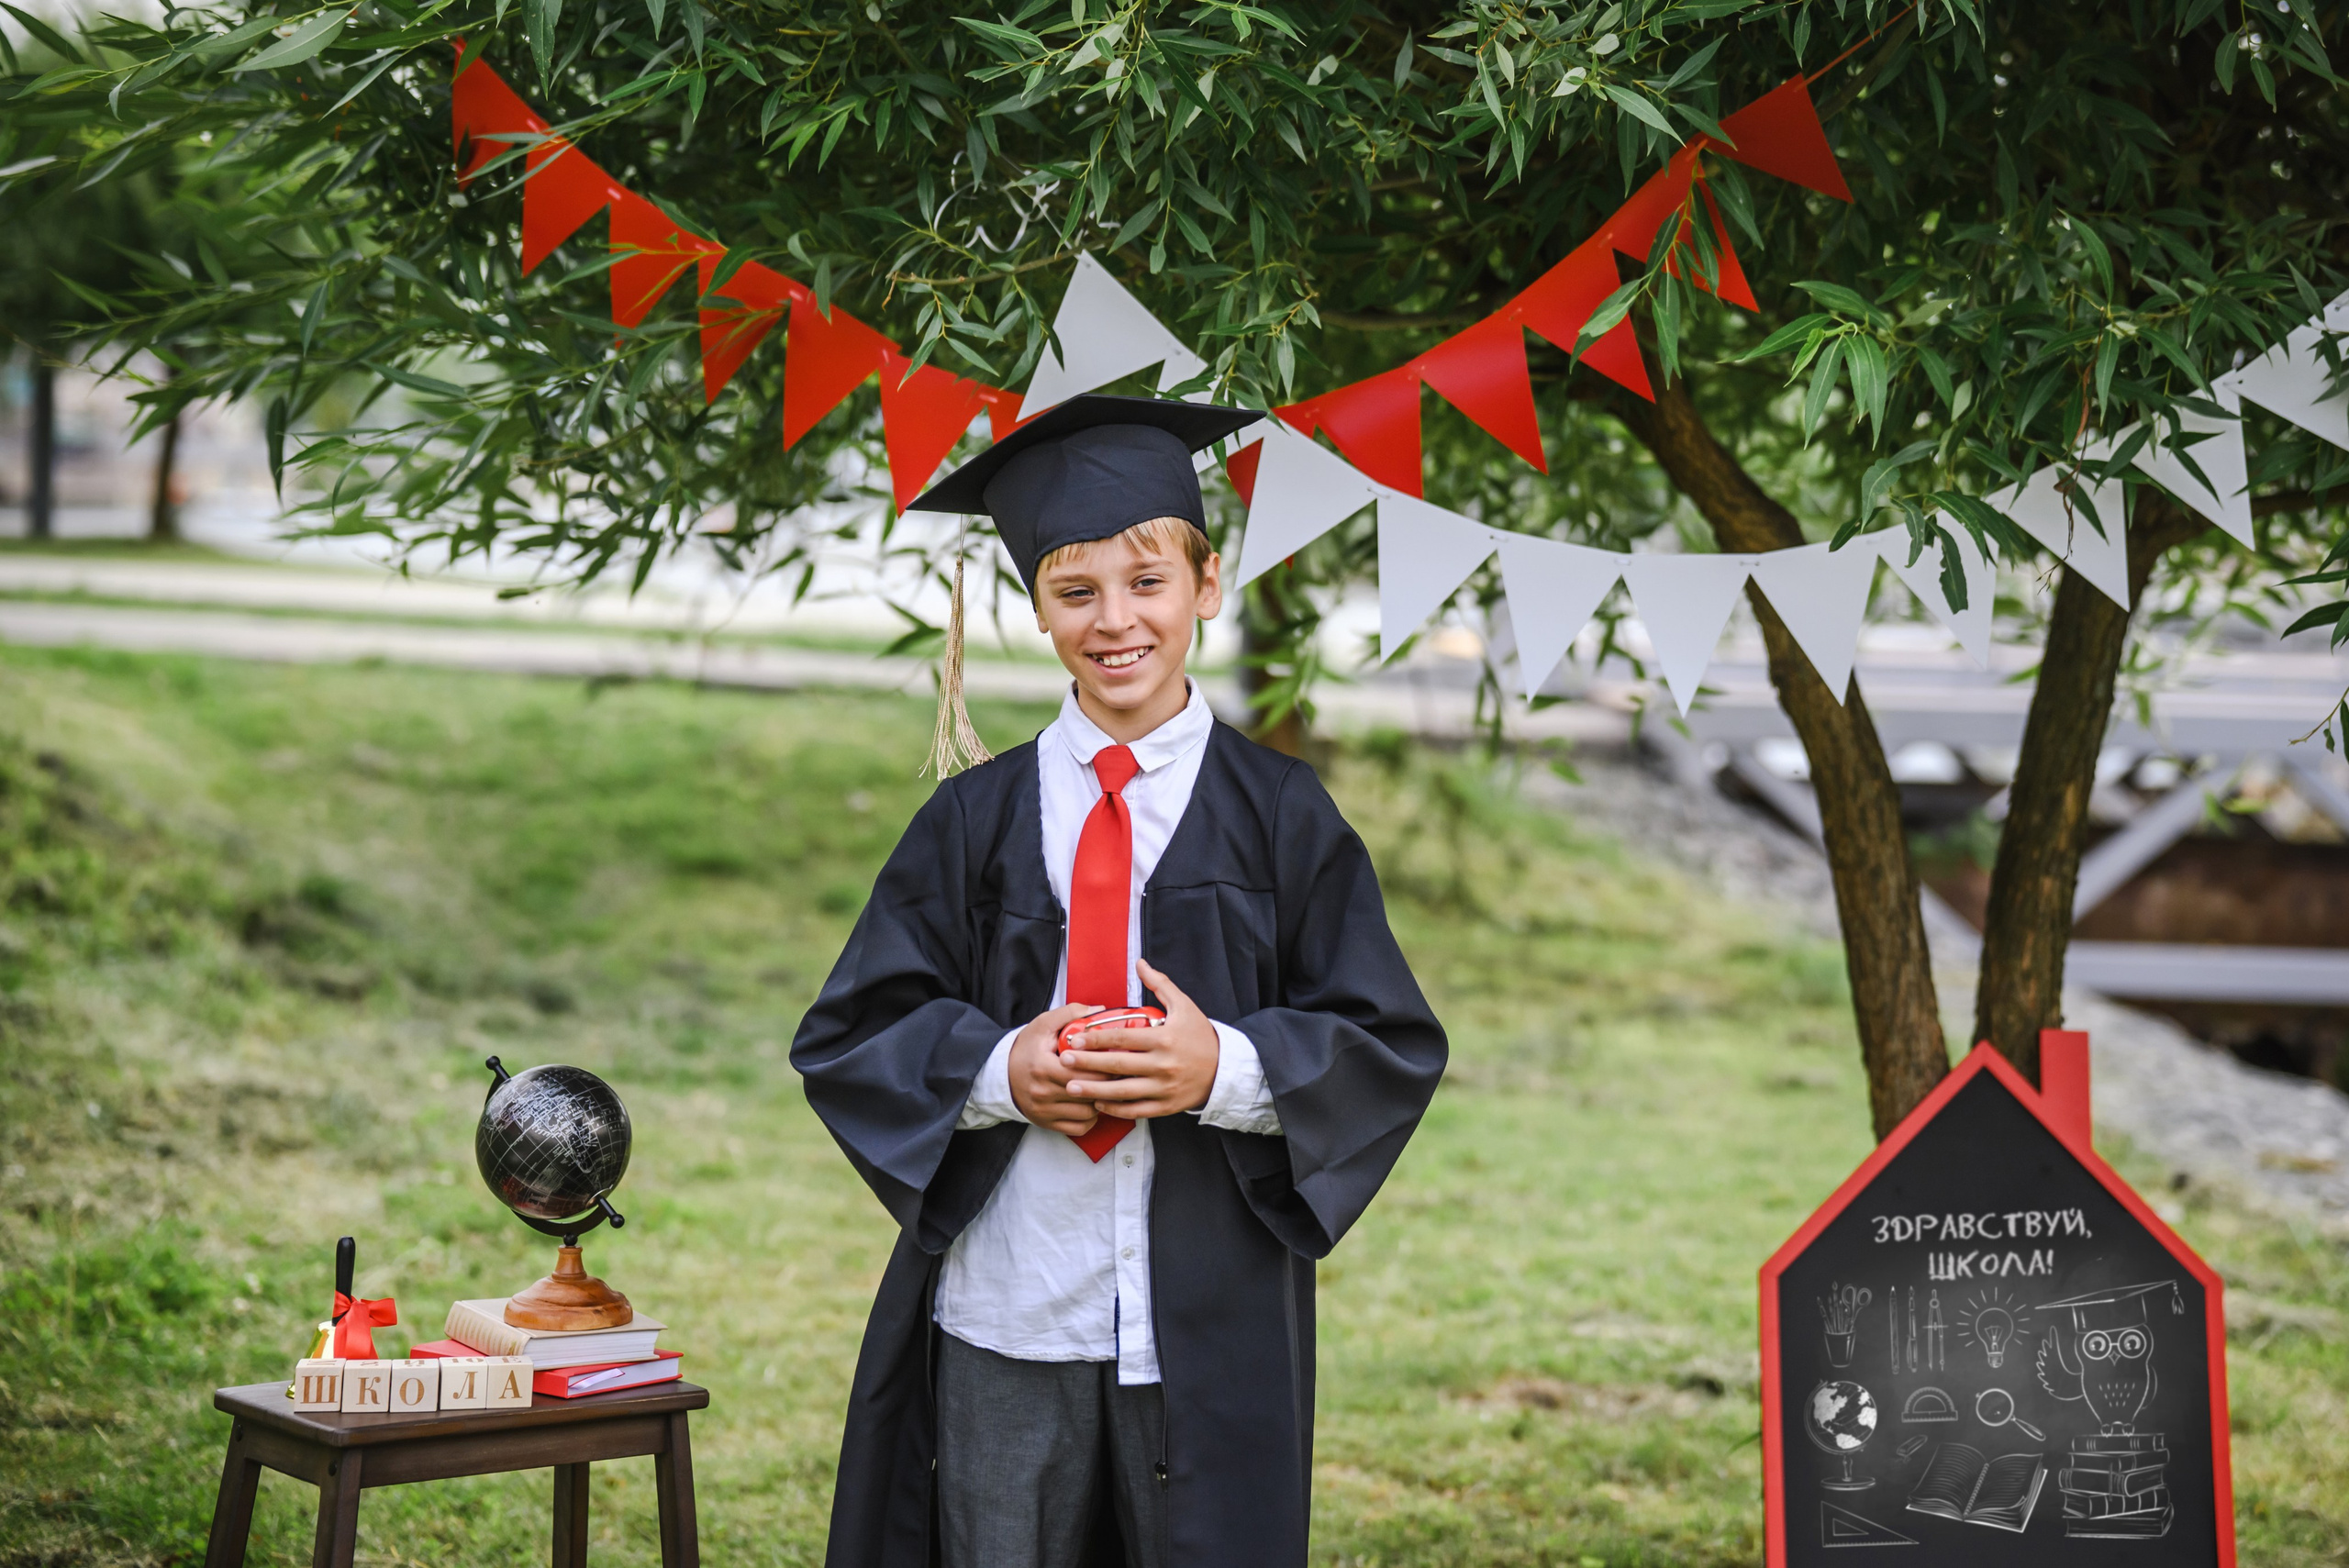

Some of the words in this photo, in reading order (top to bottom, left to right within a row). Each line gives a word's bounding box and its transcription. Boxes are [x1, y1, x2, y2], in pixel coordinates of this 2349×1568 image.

[1871, 1207, 2092, 1243] ЗДРАВСТВУЙ,
[1929, 1249, 2054, 1281] ШКОЛА!
[300, 1370, 523, 1406] ШКОЛА
